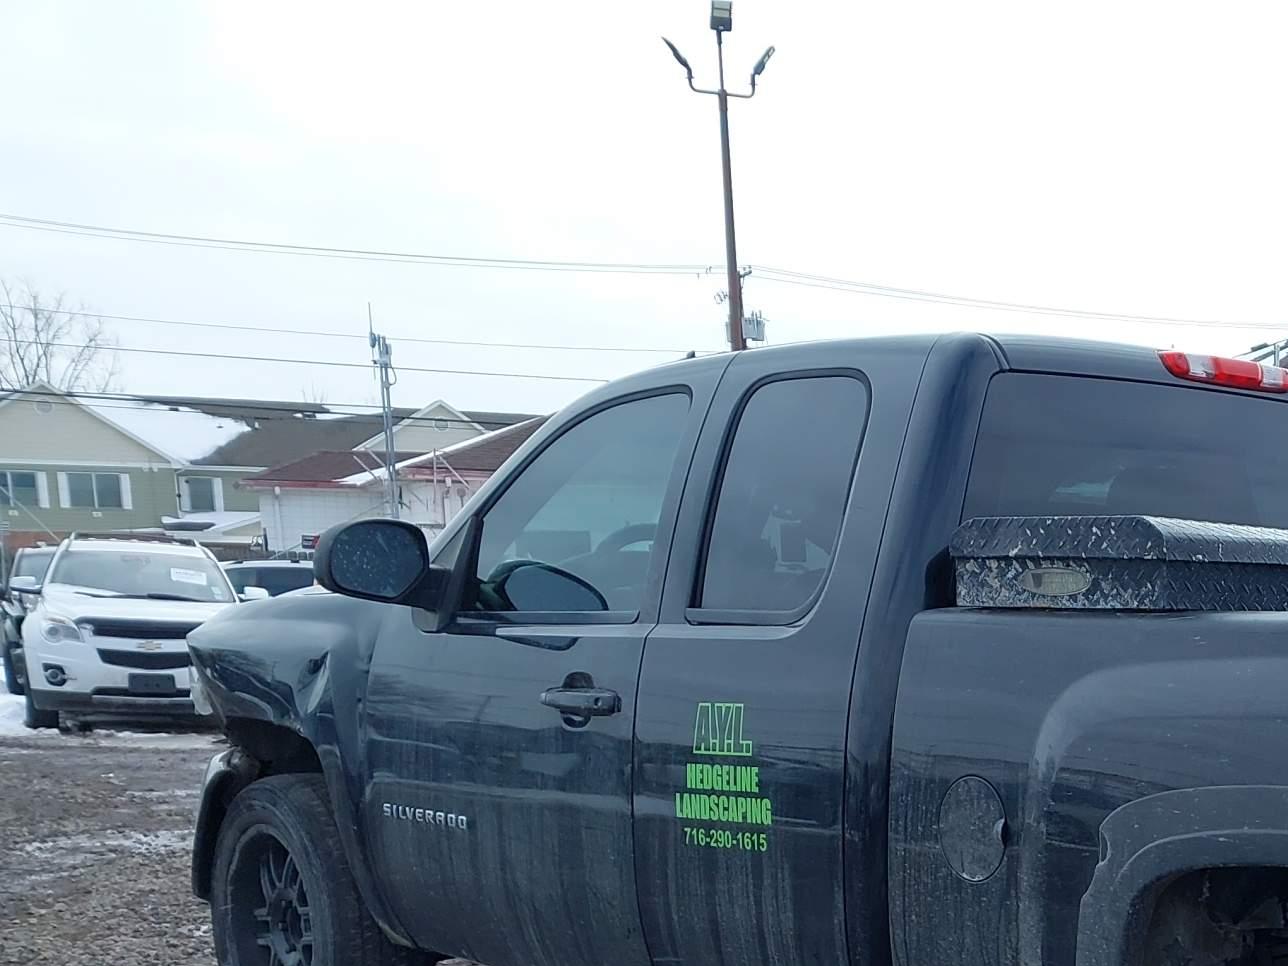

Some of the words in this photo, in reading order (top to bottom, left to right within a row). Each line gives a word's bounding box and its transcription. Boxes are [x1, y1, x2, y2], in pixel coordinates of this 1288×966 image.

[687, 763, 759, 792] HEDGELINE
[383, 803, 467, 829] SILVERADO
[676, 793, 772, 824] LANDSCAPING
[684, 828, 767, 851] 716-290-1615
